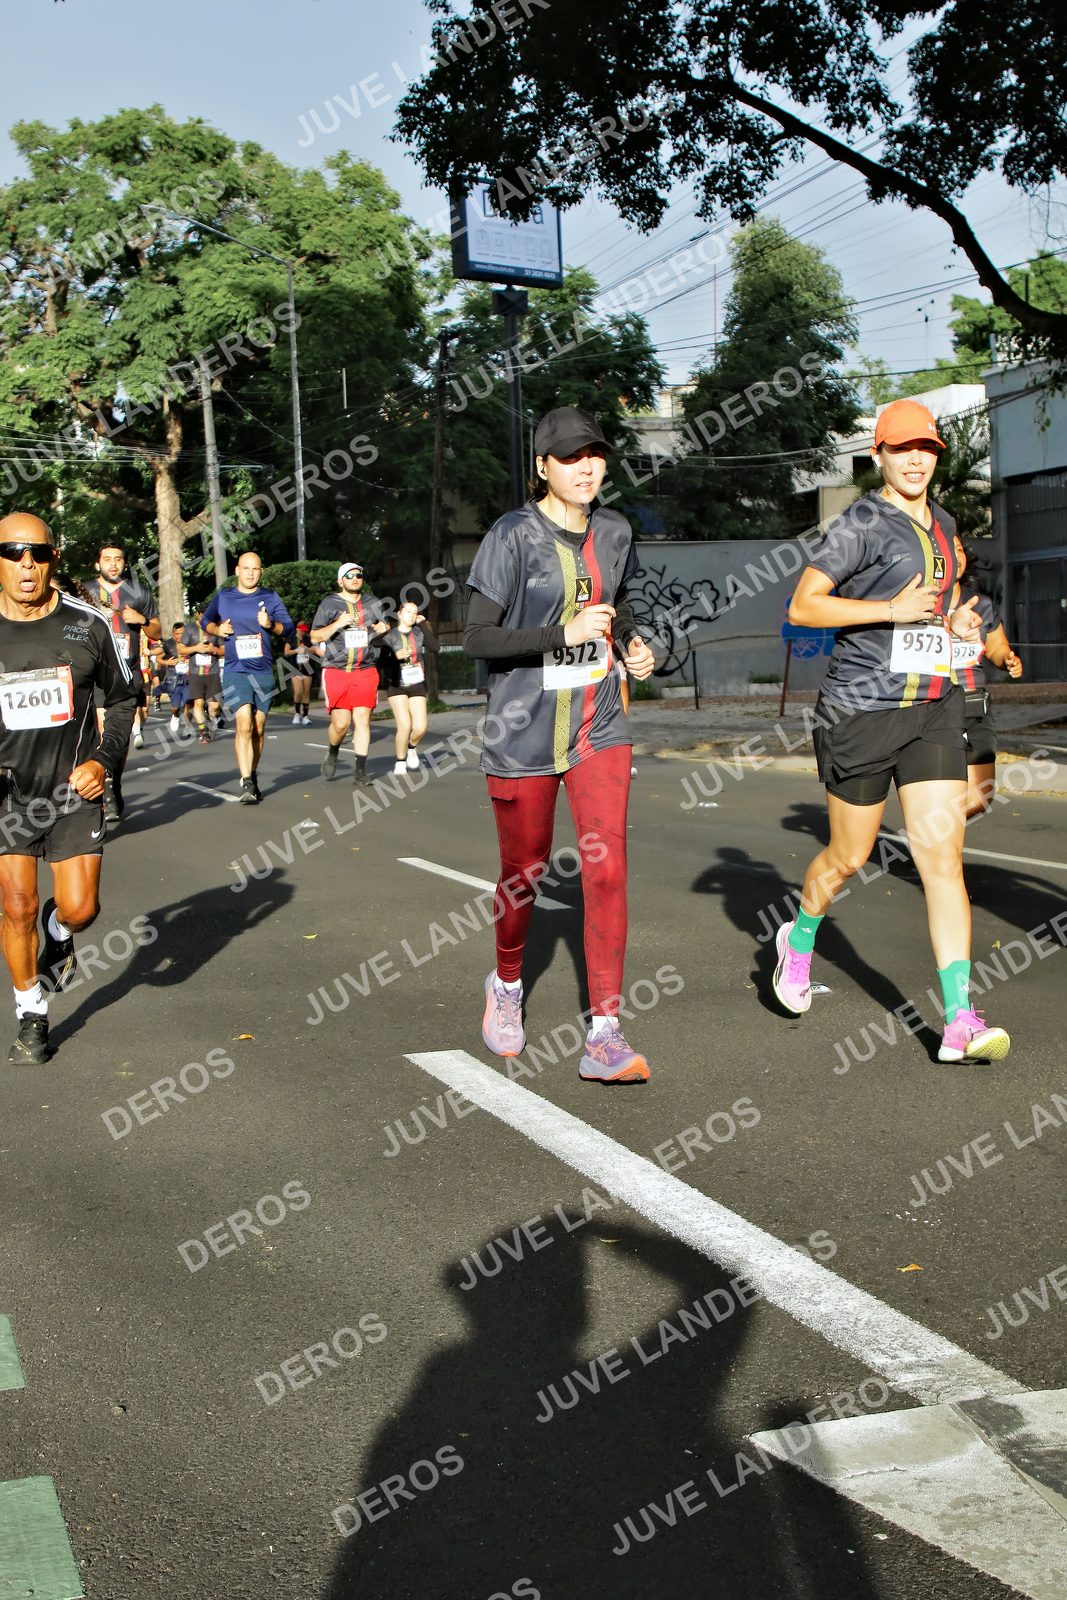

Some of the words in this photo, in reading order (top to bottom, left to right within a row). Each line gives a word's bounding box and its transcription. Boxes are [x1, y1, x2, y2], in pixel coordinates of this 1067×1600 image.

[552, 640, 598, 667] 9572
[902, 631, 944, 654] 9573
[3, 686, 63, 710] 12601
